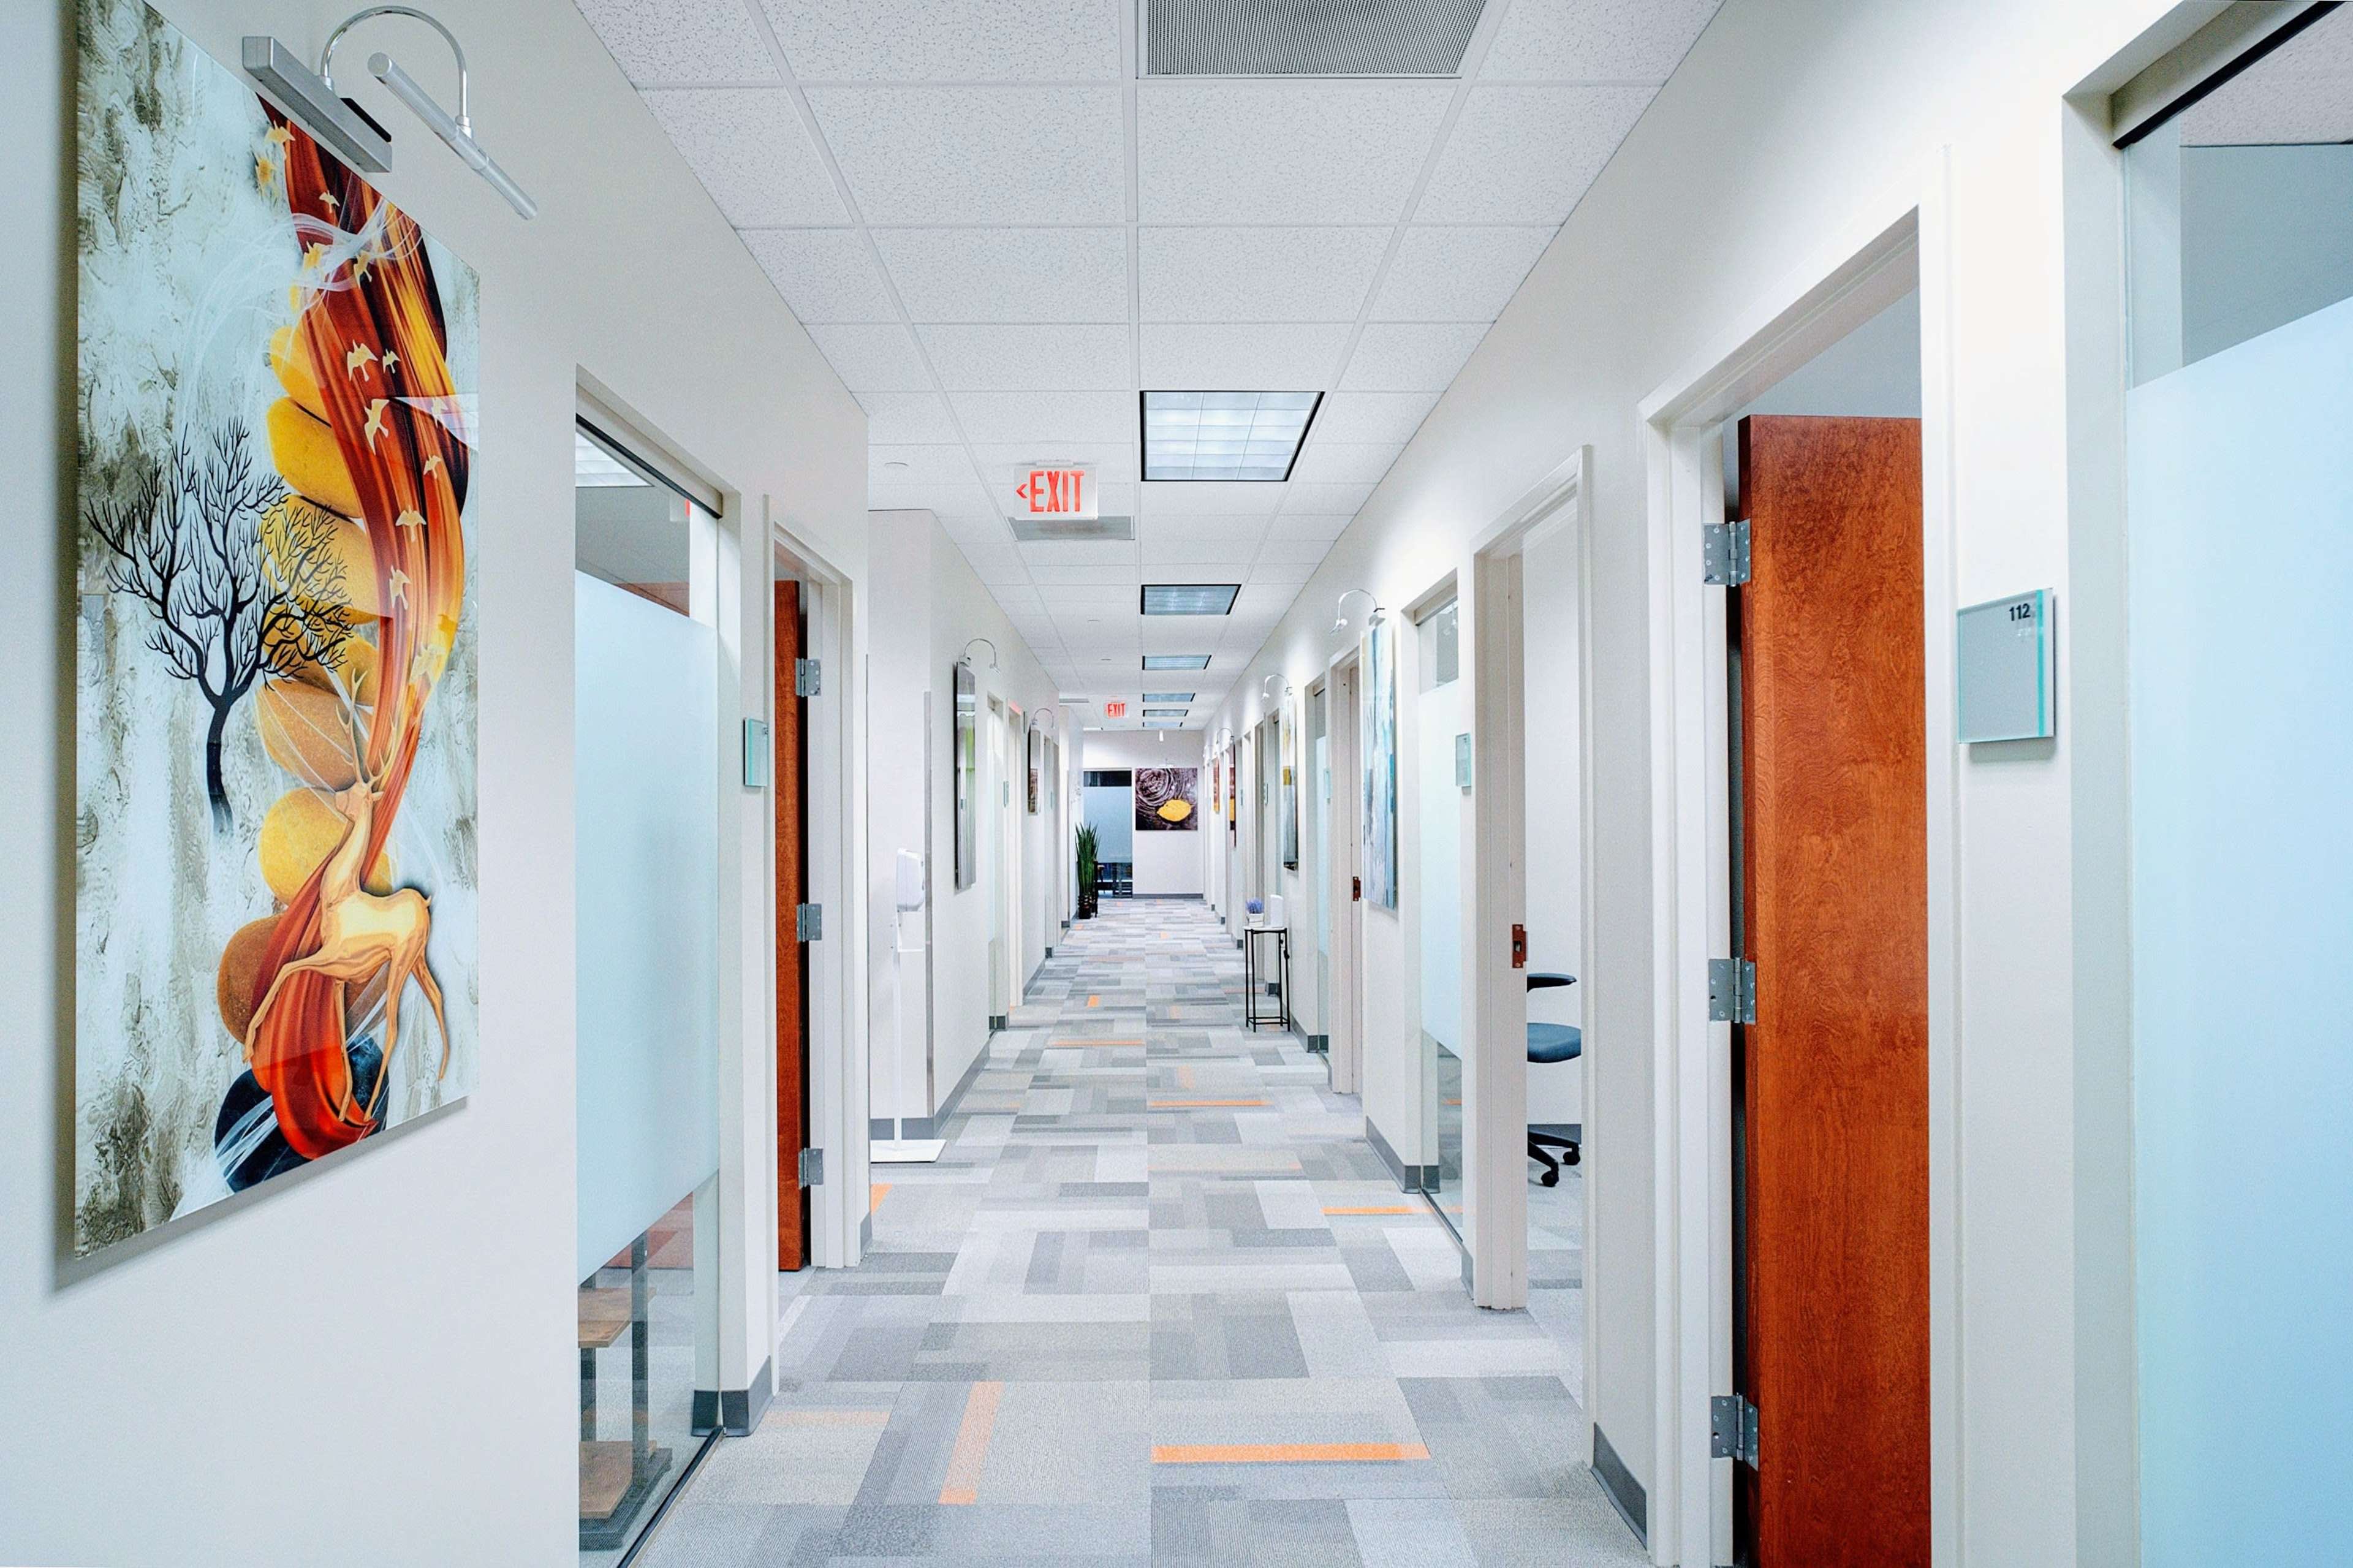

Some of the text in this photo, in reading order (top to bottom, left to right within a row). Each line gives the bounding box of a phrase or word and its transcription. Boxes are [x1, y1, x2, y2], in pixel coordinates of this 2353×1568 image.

[1029, 471, 1085, 512] EXIT
[2009, 603, 2031, 621] 112
[1107, 703, 1126, 718] EXIT
